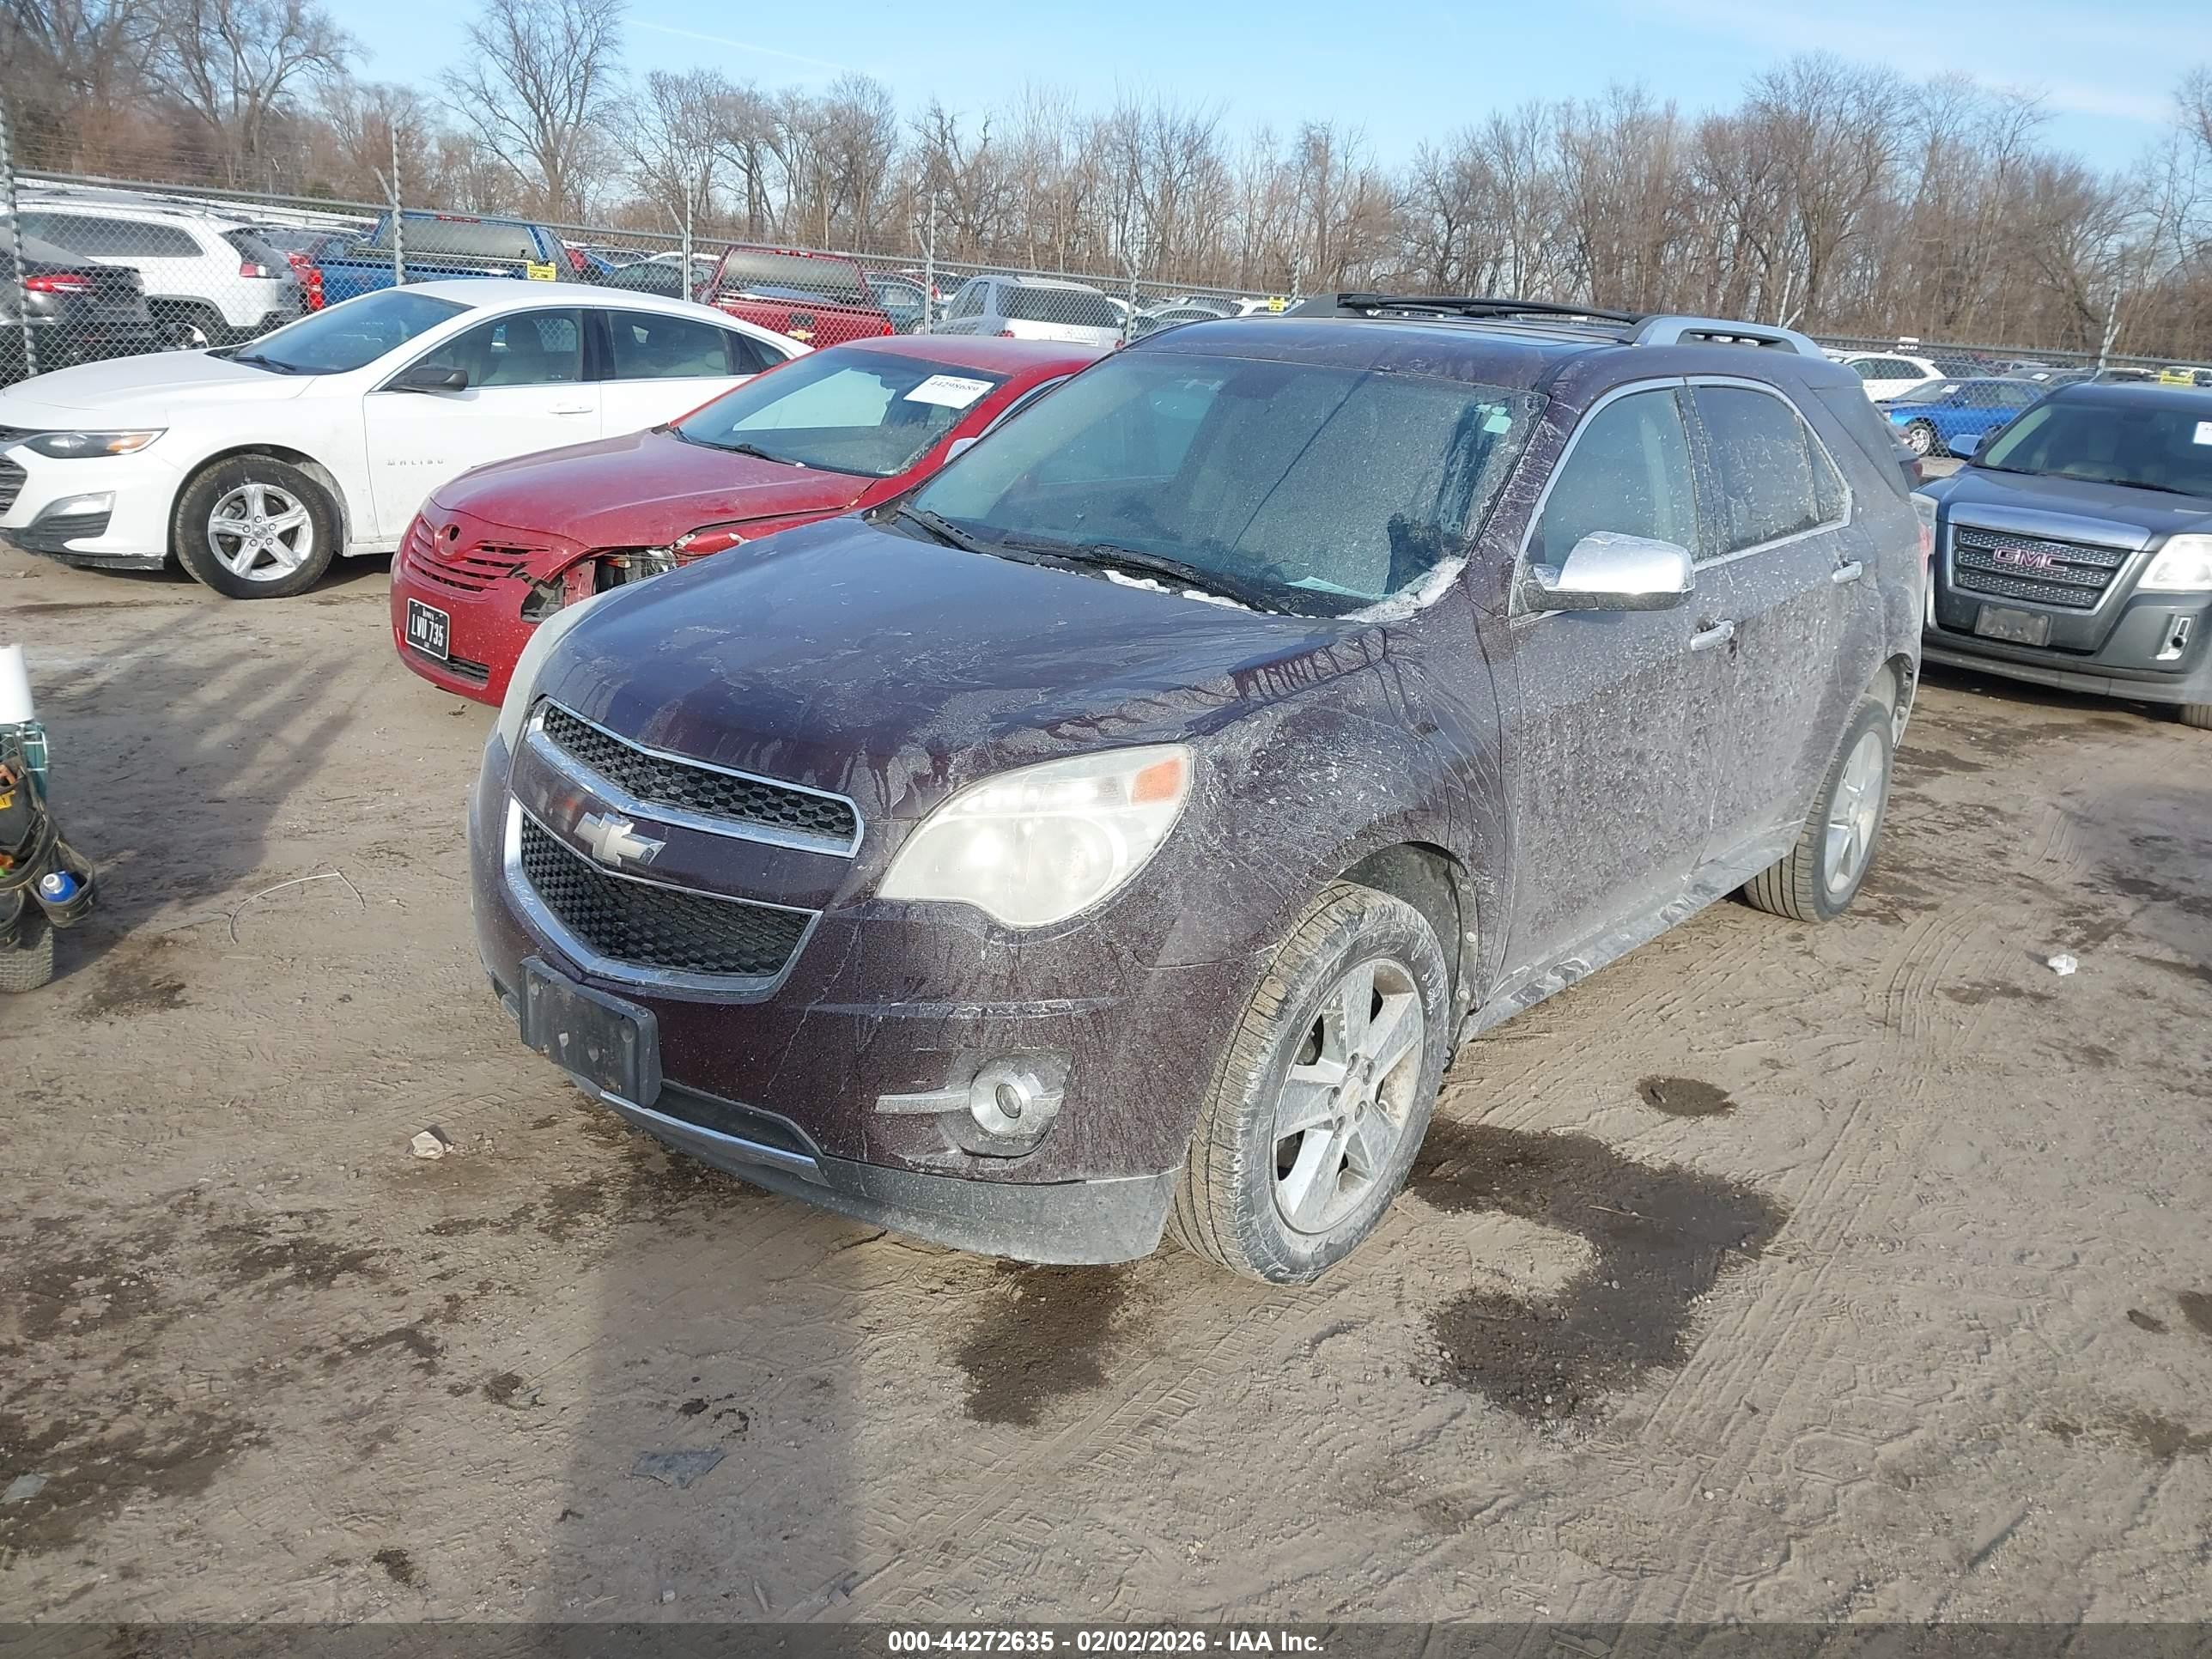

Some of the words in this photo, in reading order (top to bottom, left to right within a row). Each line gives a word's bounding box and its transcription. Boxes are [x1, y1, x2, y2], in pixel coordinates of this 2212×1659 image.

[1993, 546, 2070, 572] GMC
[411, 613, 428, 640] LVU
[428, 620, 444, 647] 735
